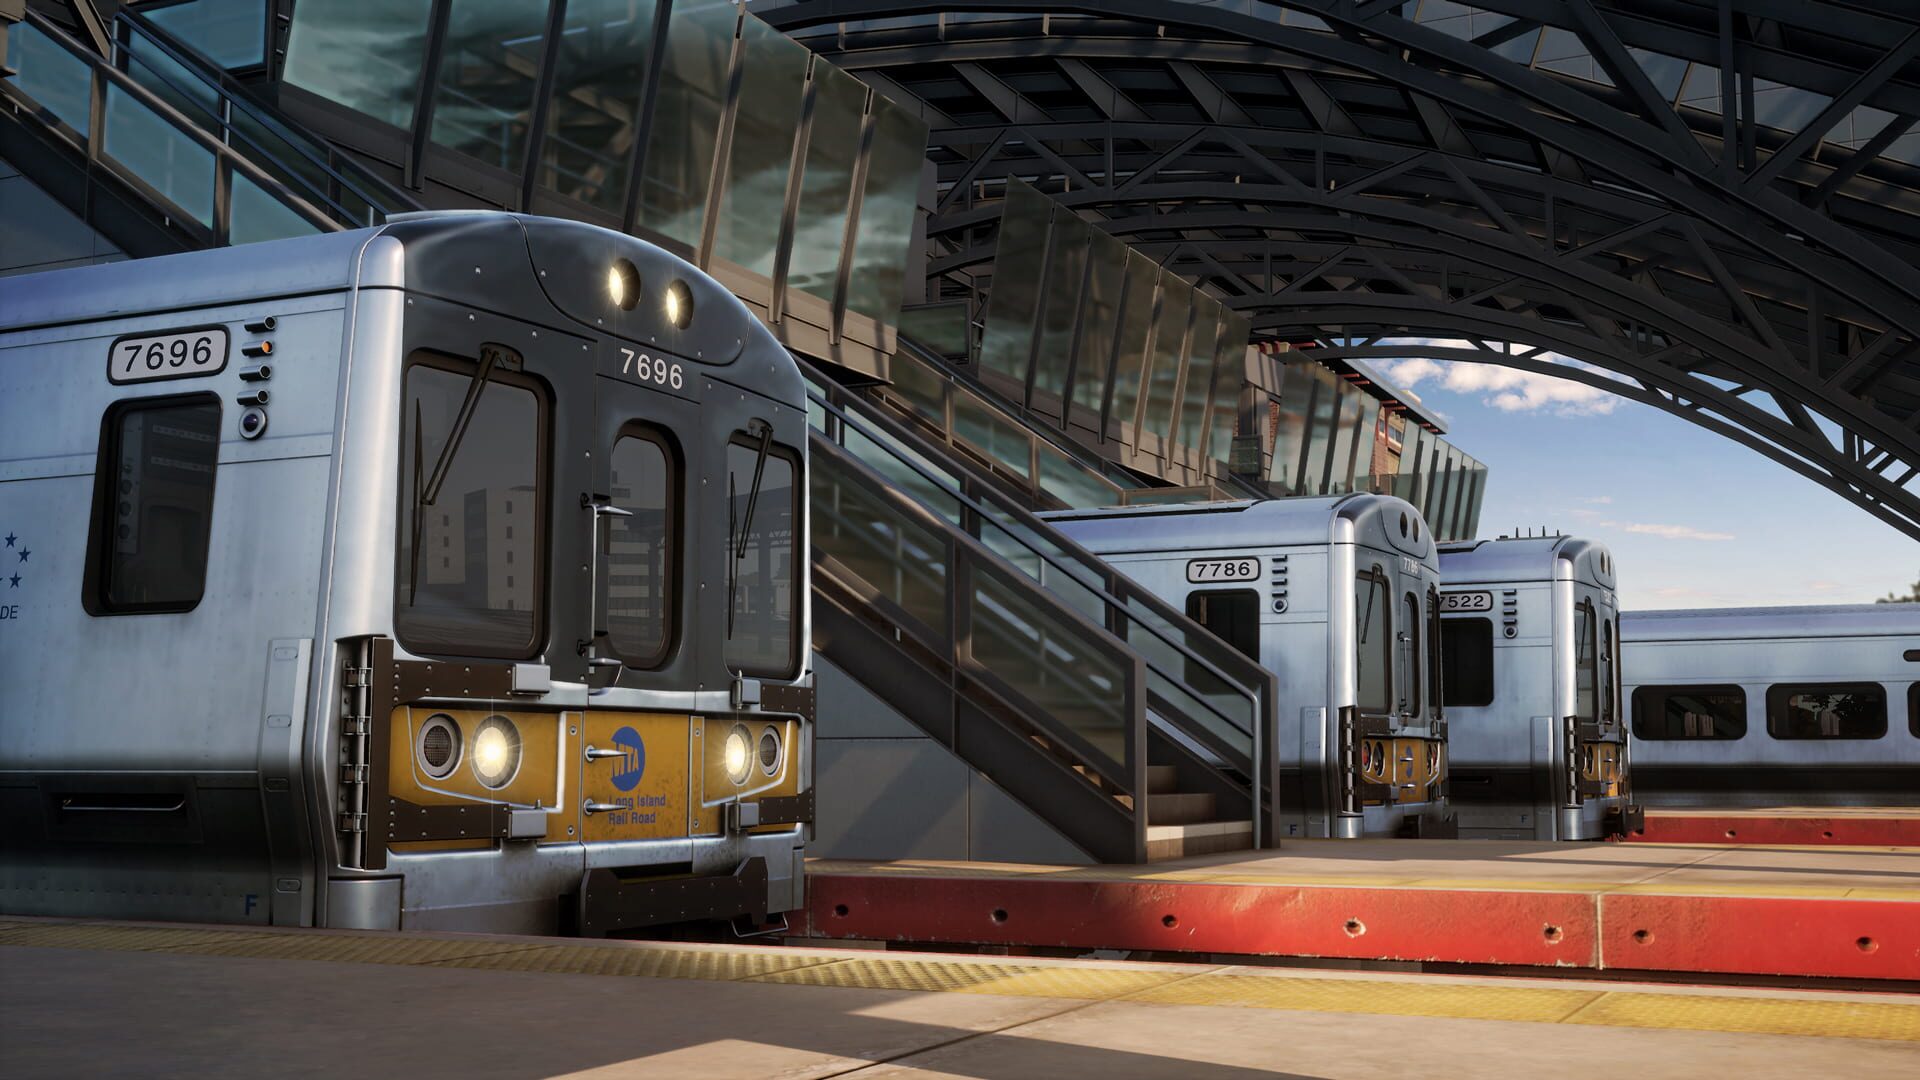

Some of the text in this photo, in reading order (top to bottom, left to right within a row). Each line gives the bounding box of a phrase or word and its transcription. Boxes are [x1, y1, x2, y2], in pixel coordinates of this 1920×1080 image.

[124, 336, 211, 372] 7696
[620, 347, 683, 390] 7696
[1195, 562, 1250, 577] 7786
[637, 794, 666, 807] Island
[608, 811, 656, 825] Rail Road
[1290, 824, 1297, 835] F
[245, 894, 257, 916] F
